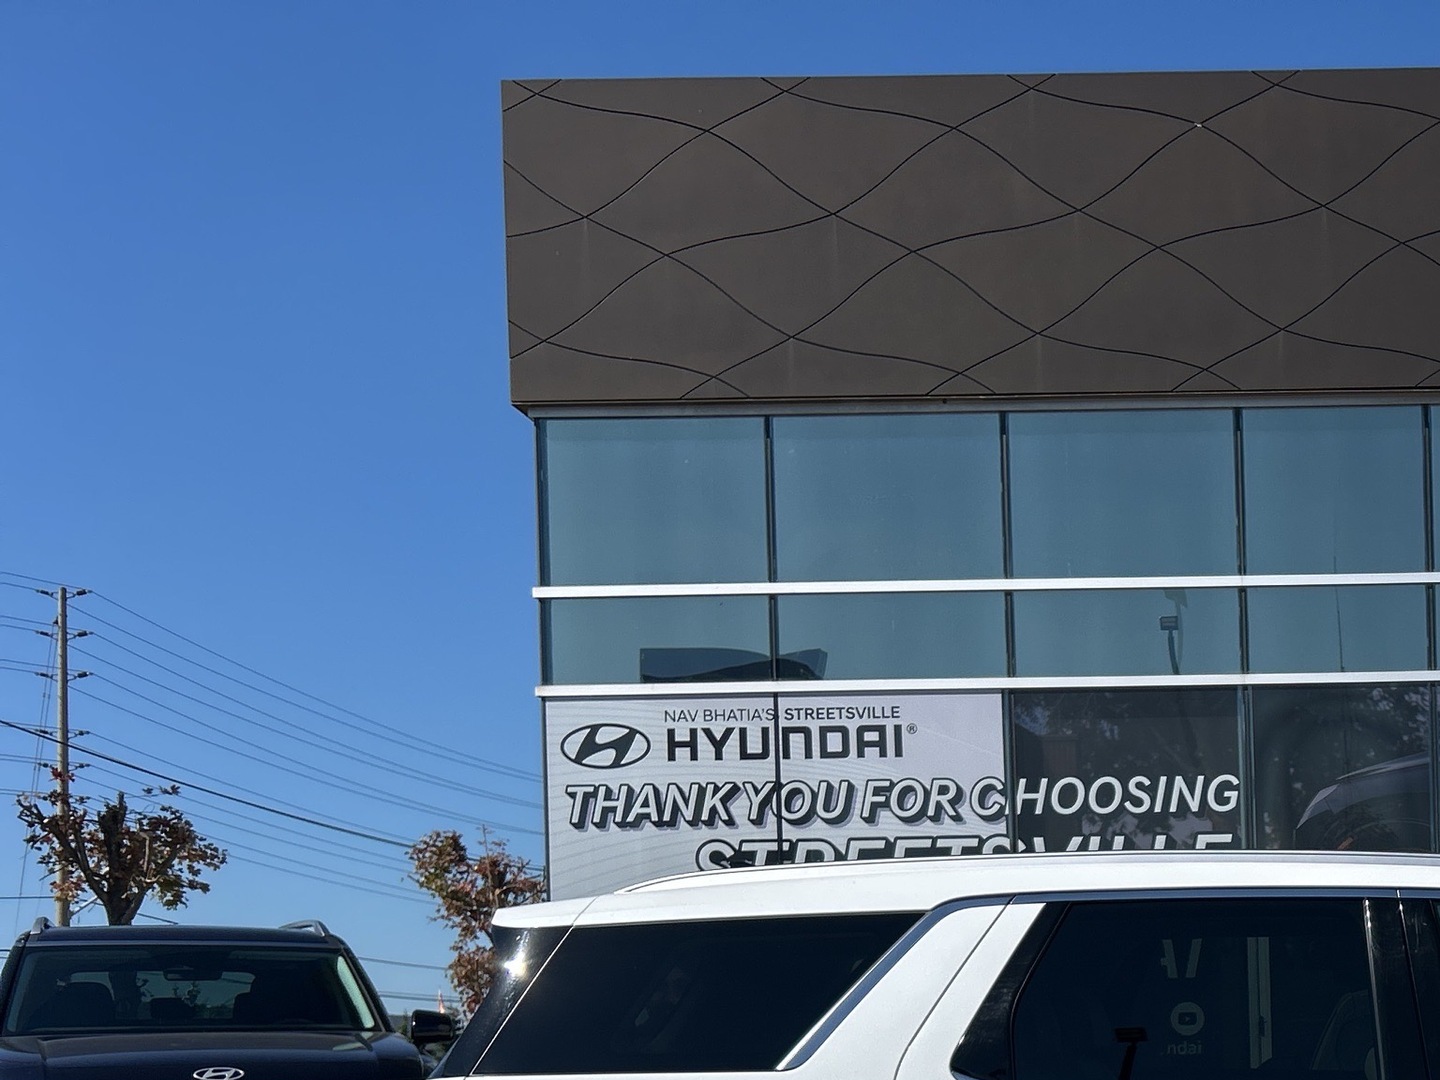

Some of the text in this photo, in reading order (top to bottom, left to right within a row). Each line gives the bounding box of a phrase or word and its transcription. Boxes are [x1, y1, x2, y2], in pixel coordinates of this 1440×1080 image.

[664, 705, 901, 723] NAV BHATIA'S STREETSVILLE
[565, 774, 1240, 830] THANK YOU FOR CHOOSING
